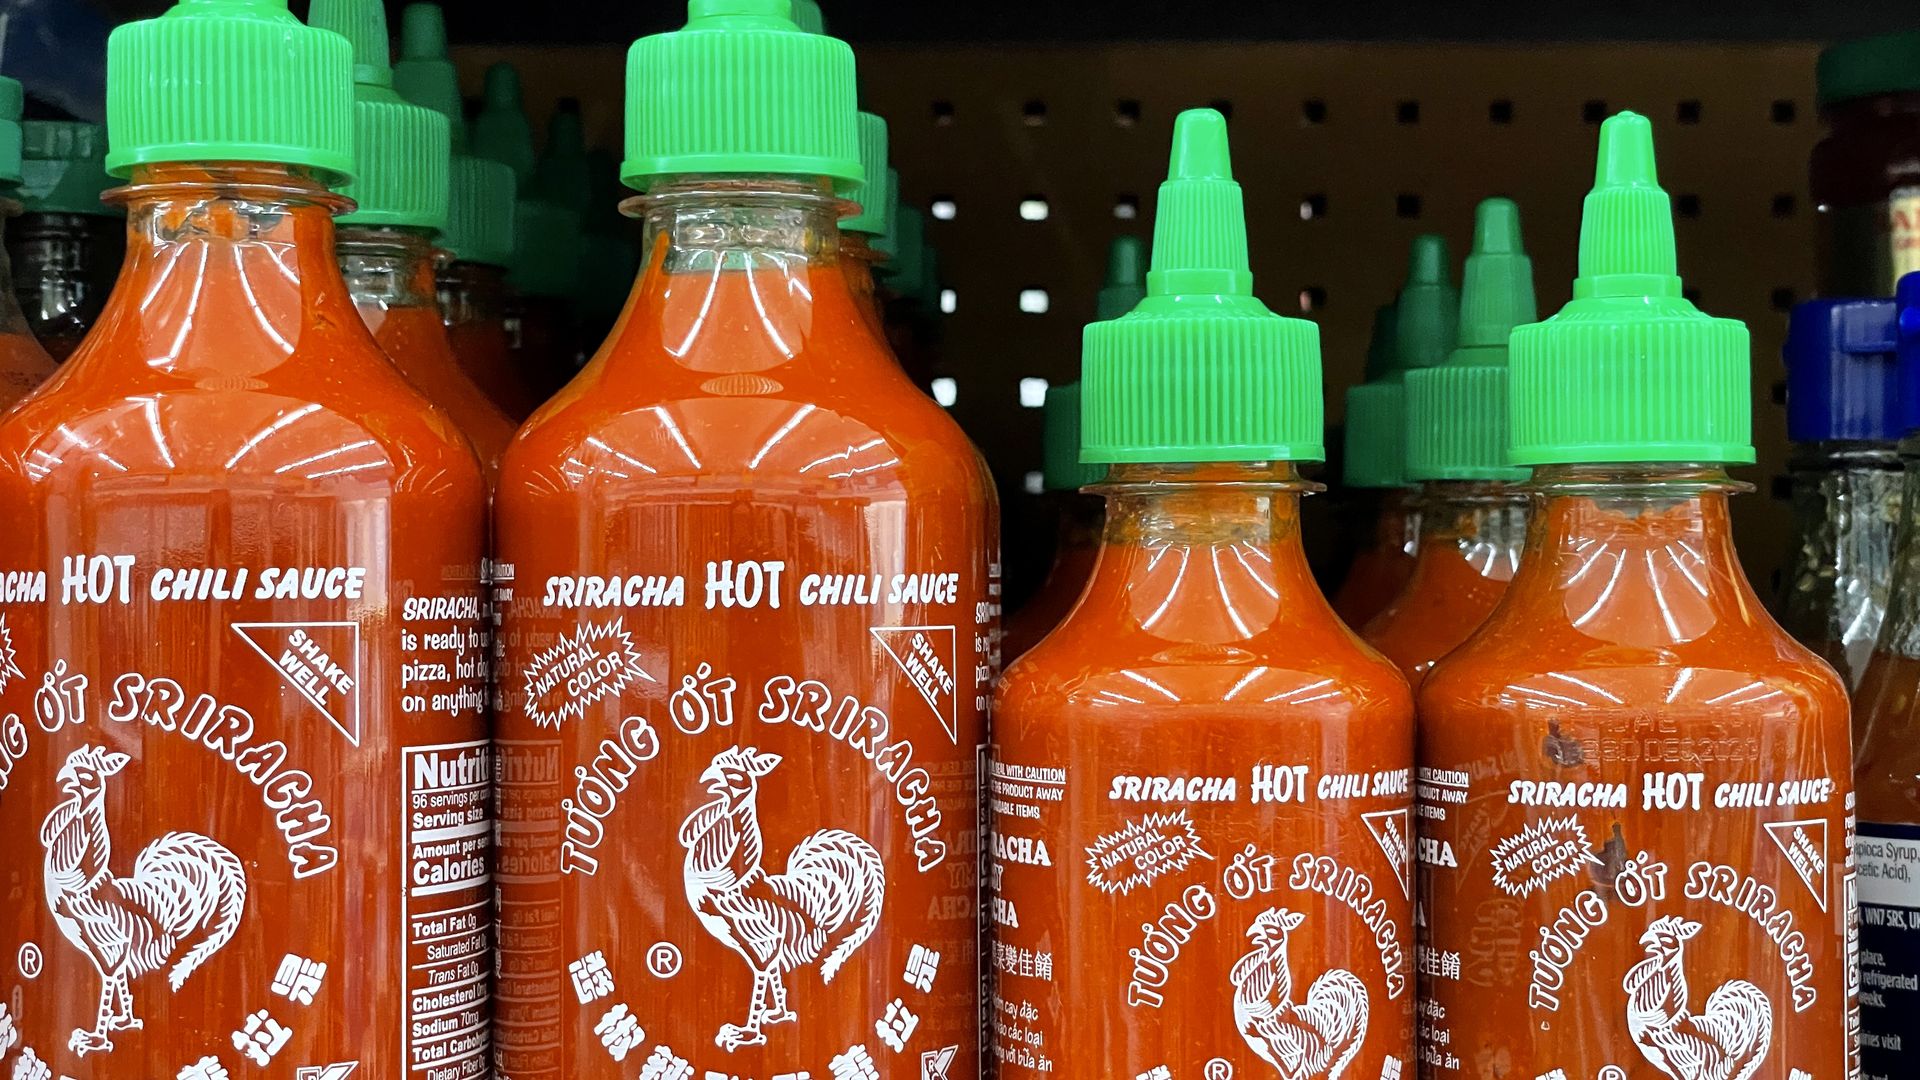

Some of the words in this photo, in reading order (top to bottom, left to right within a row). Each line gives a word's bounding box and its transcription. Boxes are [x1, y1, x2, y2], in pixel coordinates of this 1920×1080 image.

[62, 554, 135, 605] HOT
[151, 568, 247, 601] CHILI
[255, 568, 366, 600] SAUCE
[543, 575, 685, 608] SRIRACHA
[705, 559, 785, 610] HOT
[800, 574, 879, 606] CHILI
[888, 573, 960, 605] SAUCE
[401, 628, 418, 651] is
[424, 625, 465, 656] ready
[468, 627, 479, 648] to
[288, 629, 354, 697] SHAKE
[401, 659, 451, 689] pizza,
[456, 655, 475, 680] hot
[535, 643, 600, 696] NATURAL
[567, 650, 625, 696] COLOR
[911, 632, 955, 694] SHAKE
[278, 655, 329, 706] WELL
[904, 653, 939, 707] WELL
[401, 694, 426, 713] on
[432, 685, 483, 717] anything
[108, 673, 338, 880] SRIRACHA
[758, 675, 946, 873] SRIRACHA
[1006, 764, 1023, 778] WITH
[1025, 766, 1066, 782] CAUTION
[1108, 775, 1236, 803] SRIRACHA
[1251, 765, 1309, 804] HOT
[1317, 774, 1368, 800] CHILI
[1372, 768, 1409, 797] SAUCE
[1432, 769, 1468, 785] CAUTION
[412, 793, 428, 810] 96
[431, 791, 468, 808] servings
[1002, 783, 1034, 799] PRODUCT
[1036, 787, 1064, 801] AWAY
[1441, 788, 1468, 803] AWAY
[1507, 778, 1628, 808] SRIRACHA
[1642, 771, 1704, 811] HOT
[1714, 783, 1771, 808] CHILI
[1776, 777, 1830, 806] SAUCE
[412, 810, 465, 830] Serving
[467, 805, 484, 821] size
[1016, 803, 1040, 819] ITEMS
[1424, 805, 1446, 821] ITEMS
[412, 841, 460, 860] Amount
[462, 839, 476, 856] per
[1100, 828, 1166, 870] NATURAL
[1135, 836, 1186, 870] COLOR
[1381, 832, 1402, 872] WELL
[1385, 816, 1408, 862] SHAKE
[1504, 832, 1560, 872] NATURAL
[1794, 825, 1826, 874] SHAKE
[413, 854, 484, 885] Calories
[1532, 839, 1578, 875] COLOR
[1789, 840, 1815, 886] WELL
[412, 918, 446, 938] Total
[450, 914, 466, 932] Fat
[1290, 854, 1405, 1000] SRIRACHA
[1865, 907, 1885, 926] WN7
[427, 938, 470, 961] Saturated
[471, 936, 481, 951] Fat
[1684, 861, 1817, 1013] SRIRACHA
[427, 968, 455, 986] Trans
[457, 963, 470, 980] Fat
[1862, 969, 1918, 991] refrigerated
[412, 984, 476, 1013] Cholesterol
[1004, 1001, 1018, 1020] cay
[1019, 999, 1039, 1022] đặc
[1427, 998, 1445, 1020] đặc
[412, 1017, 459, 1038] Sodium
[460, 1011, 479, 1027] 70mg
[1024, 1026, 1043, 1049] loại
[1431, 1025, 1450, 1046] loại
[412, 1041, 446, 1063] Total
[1881, 1034, 1901, 1051] visit
[462, 1058, 479, 1076] Fiber
[1038, 1053, 1053, 1073] ăn
[1444, 1052, 1460, 1070] ăn
